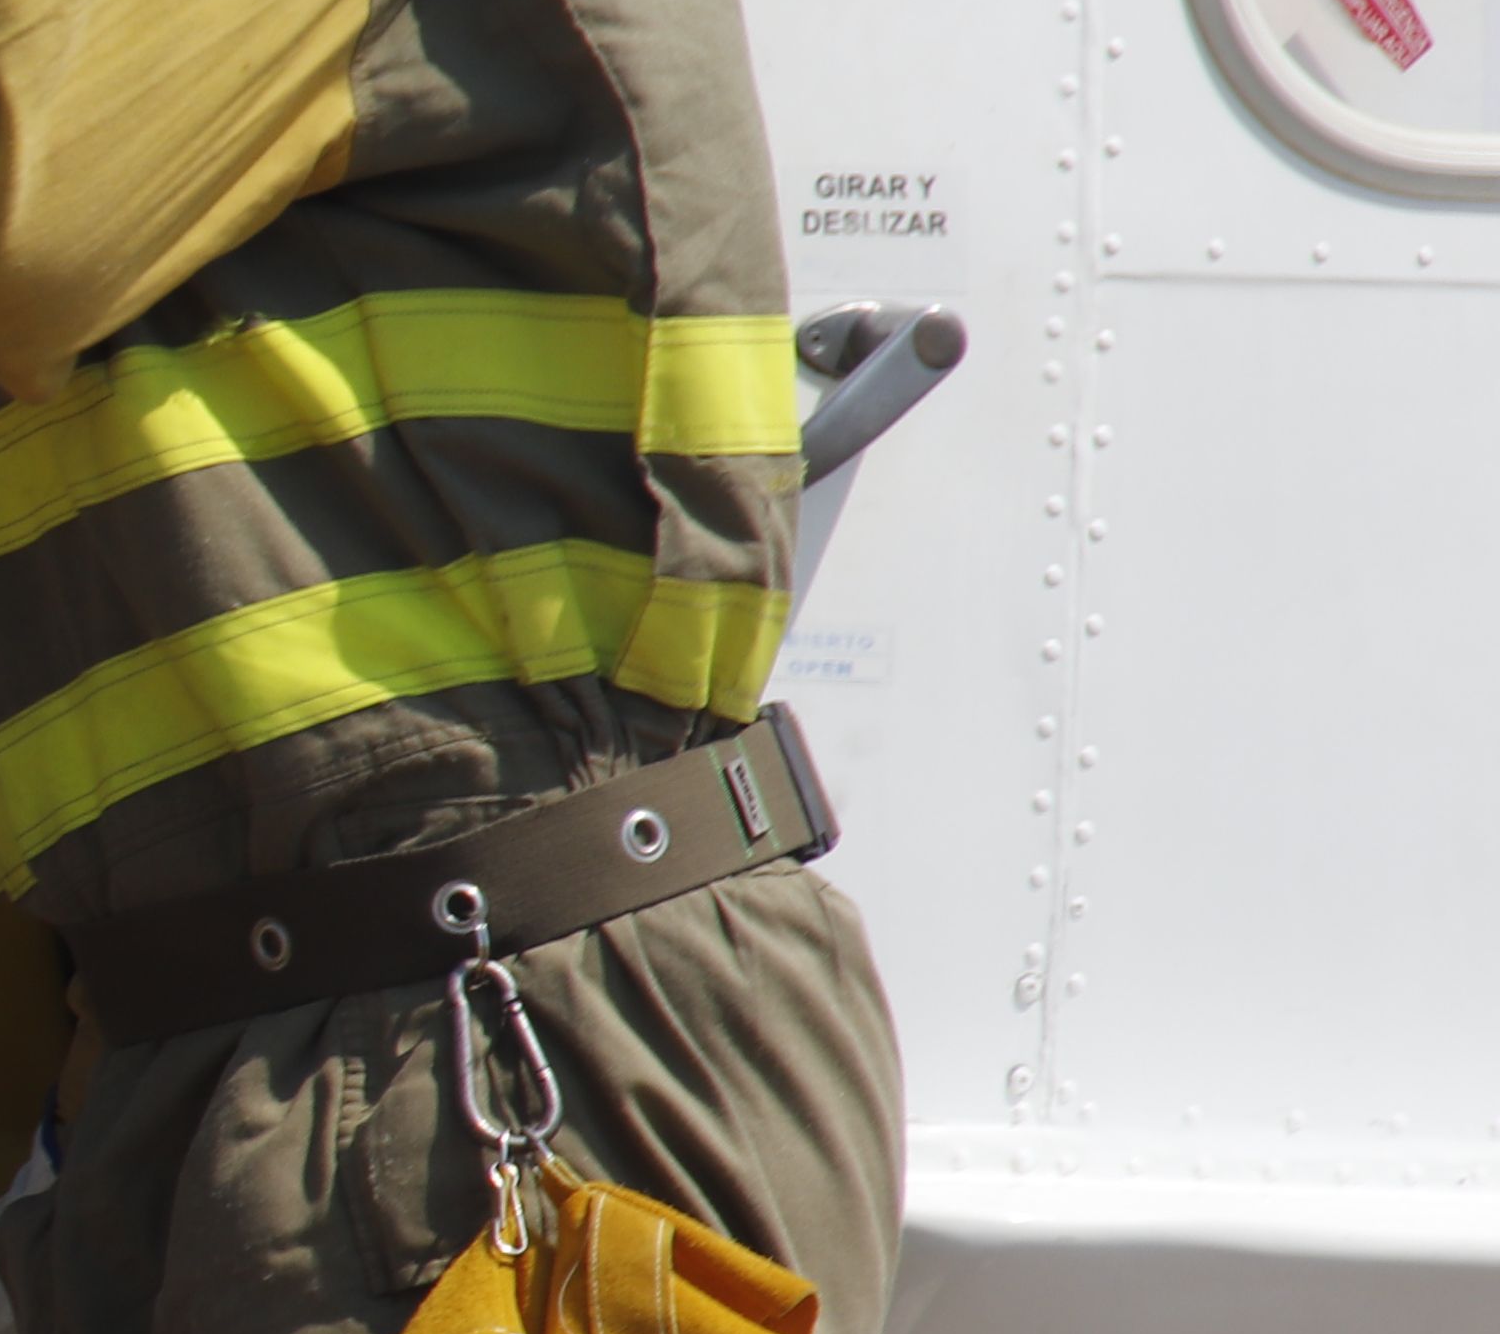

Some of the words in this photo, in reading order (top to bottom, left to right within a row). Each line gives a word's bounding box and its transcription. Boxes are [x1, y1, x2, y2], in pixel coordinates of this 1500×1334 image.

[815, 173, 908, 199] GIRAR
[919, 174, 938, 199] Y
[802, 209, 948, 236] DESLIZAR
